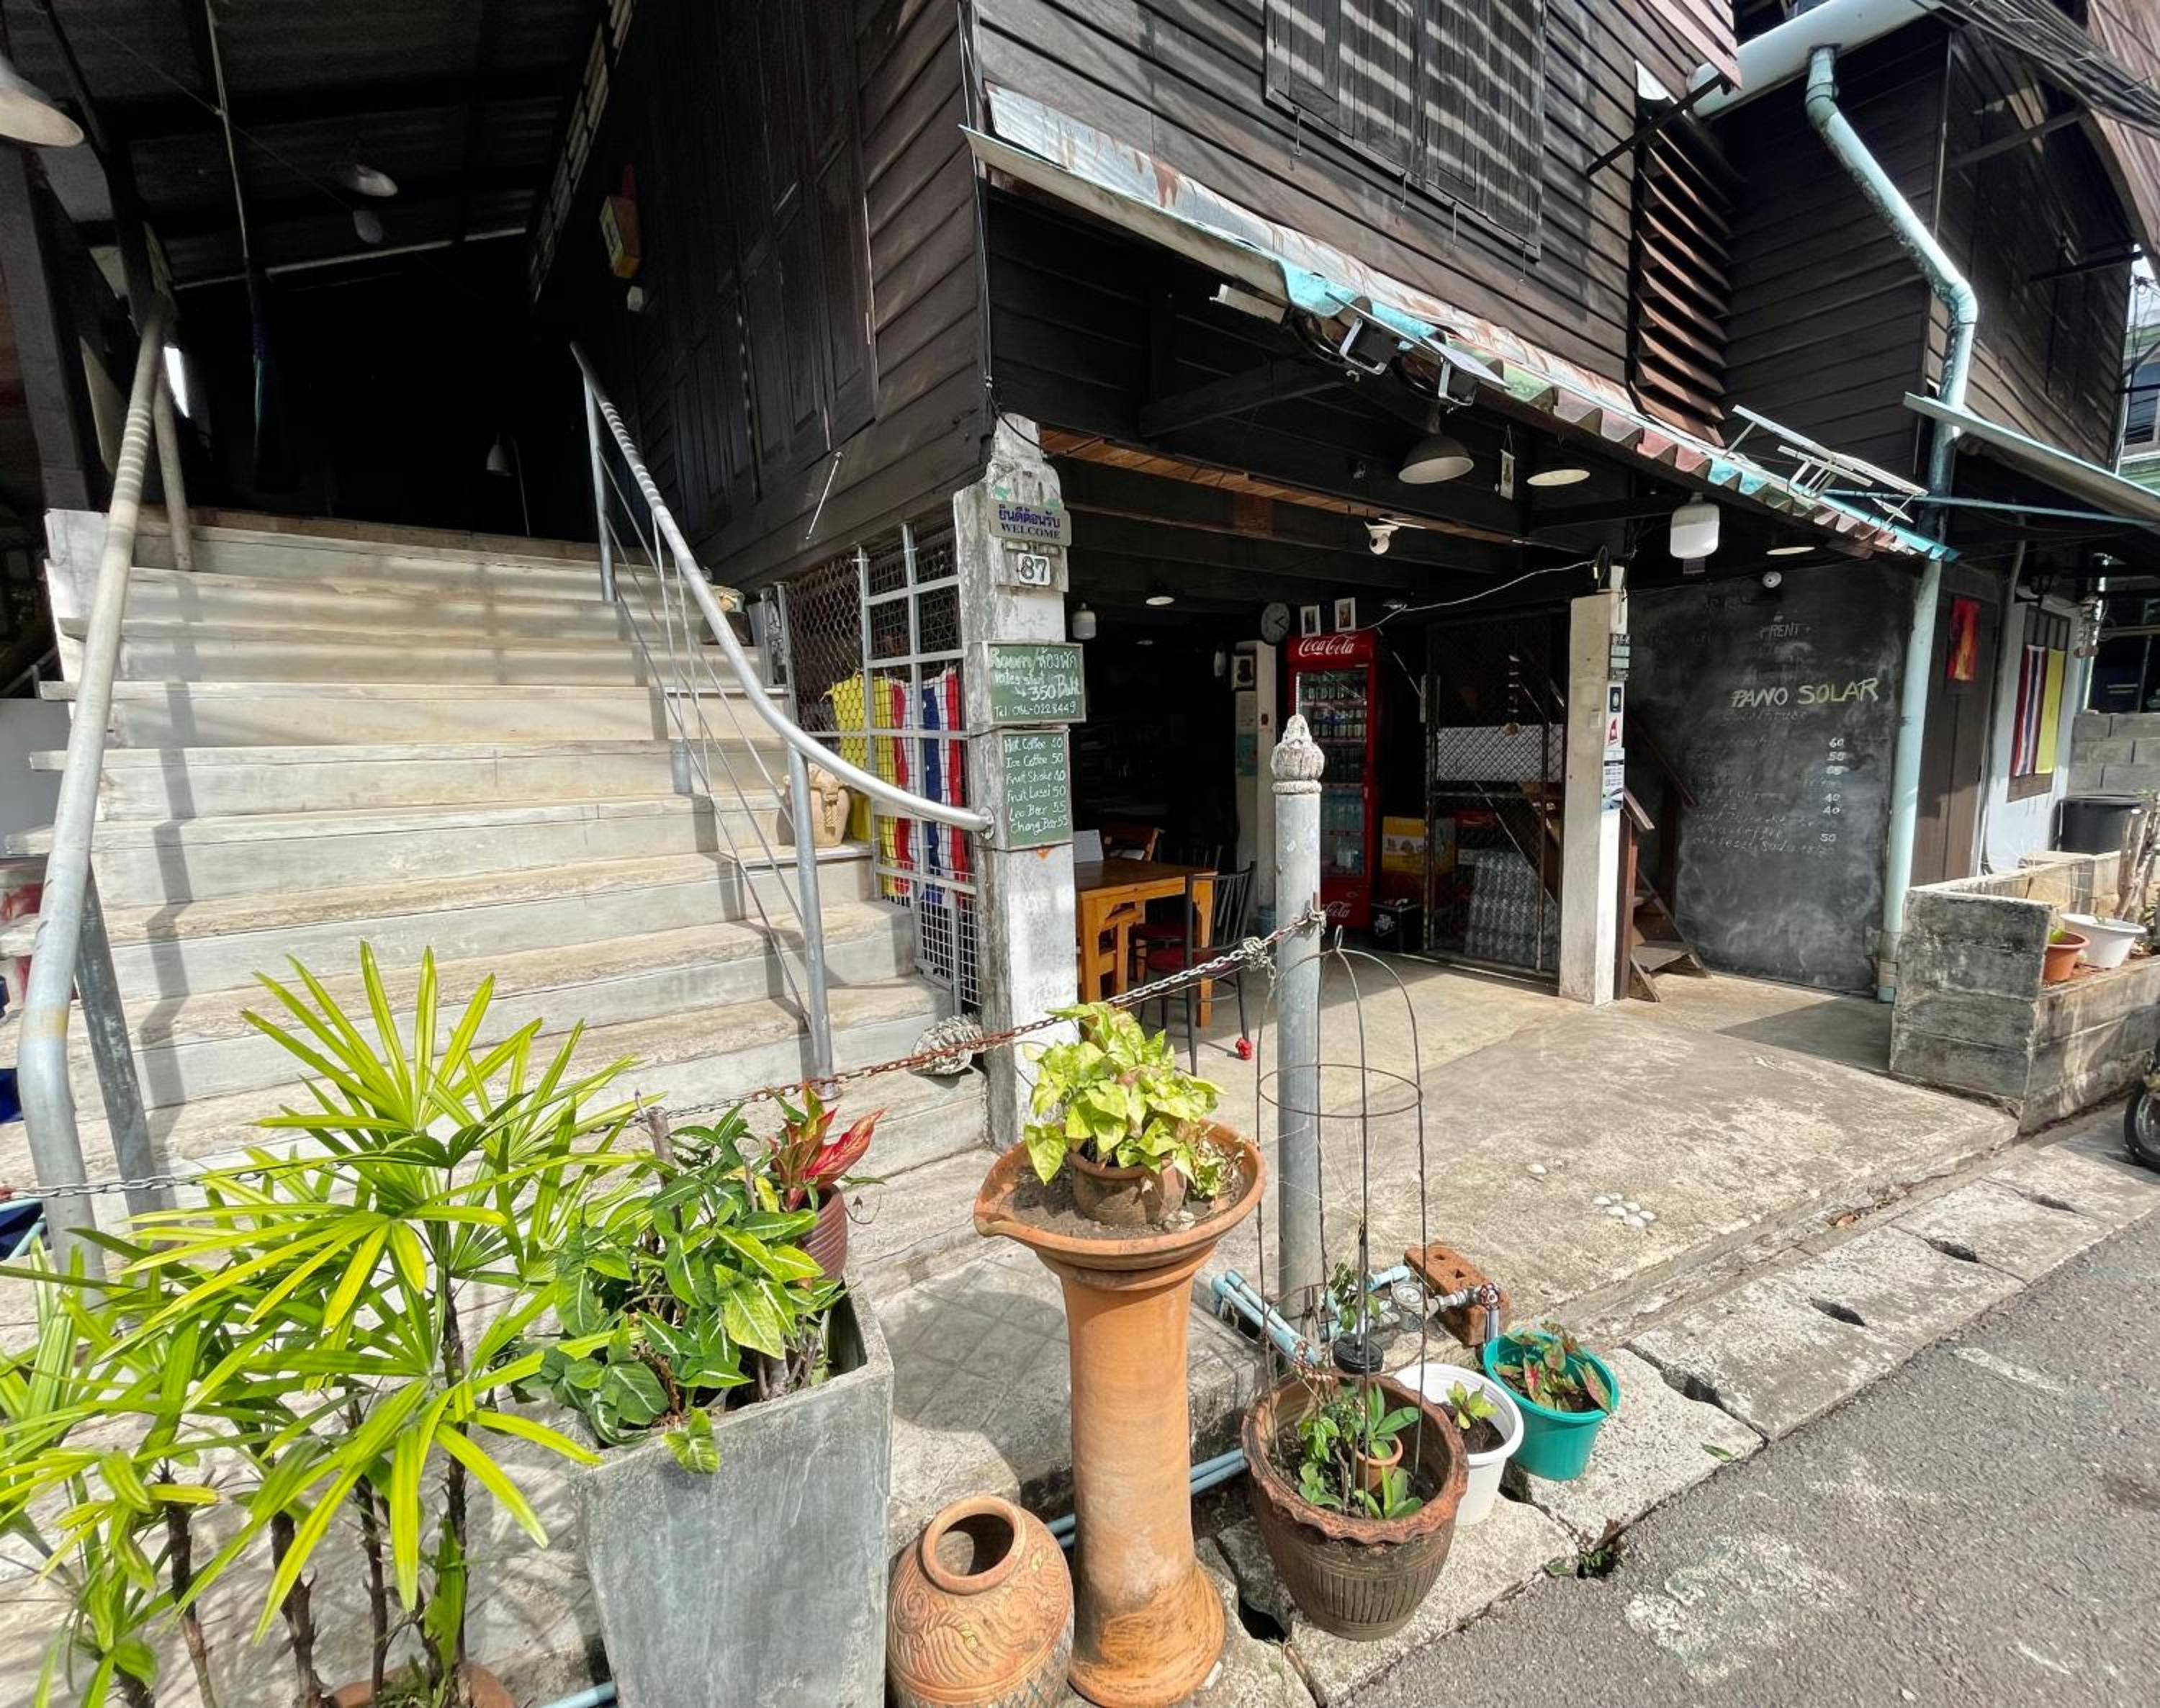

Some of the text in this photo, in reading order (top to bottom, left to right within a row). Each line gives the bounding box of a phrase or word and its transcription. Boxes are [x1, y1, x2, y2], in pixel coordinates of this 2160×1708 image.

[999, 504, 1060, 529] ยินดีต้อนรับ
[1001, 523, 1061, 539] WELCOME
[1021, 556, 1047, 582] 87
[1298, 634, 1358, 657] Coca-Cola
[1027, 684, 1056, 701] 350
[1797, 678, 1879, 705] SOLAR
[1006, 752, 1063, 768] Ice Coffee 50
[1029, 783, 1050, 799] Lassi
[1052, 785, 1066, 797] 50
[1052, 801, 1066, 813] 55
